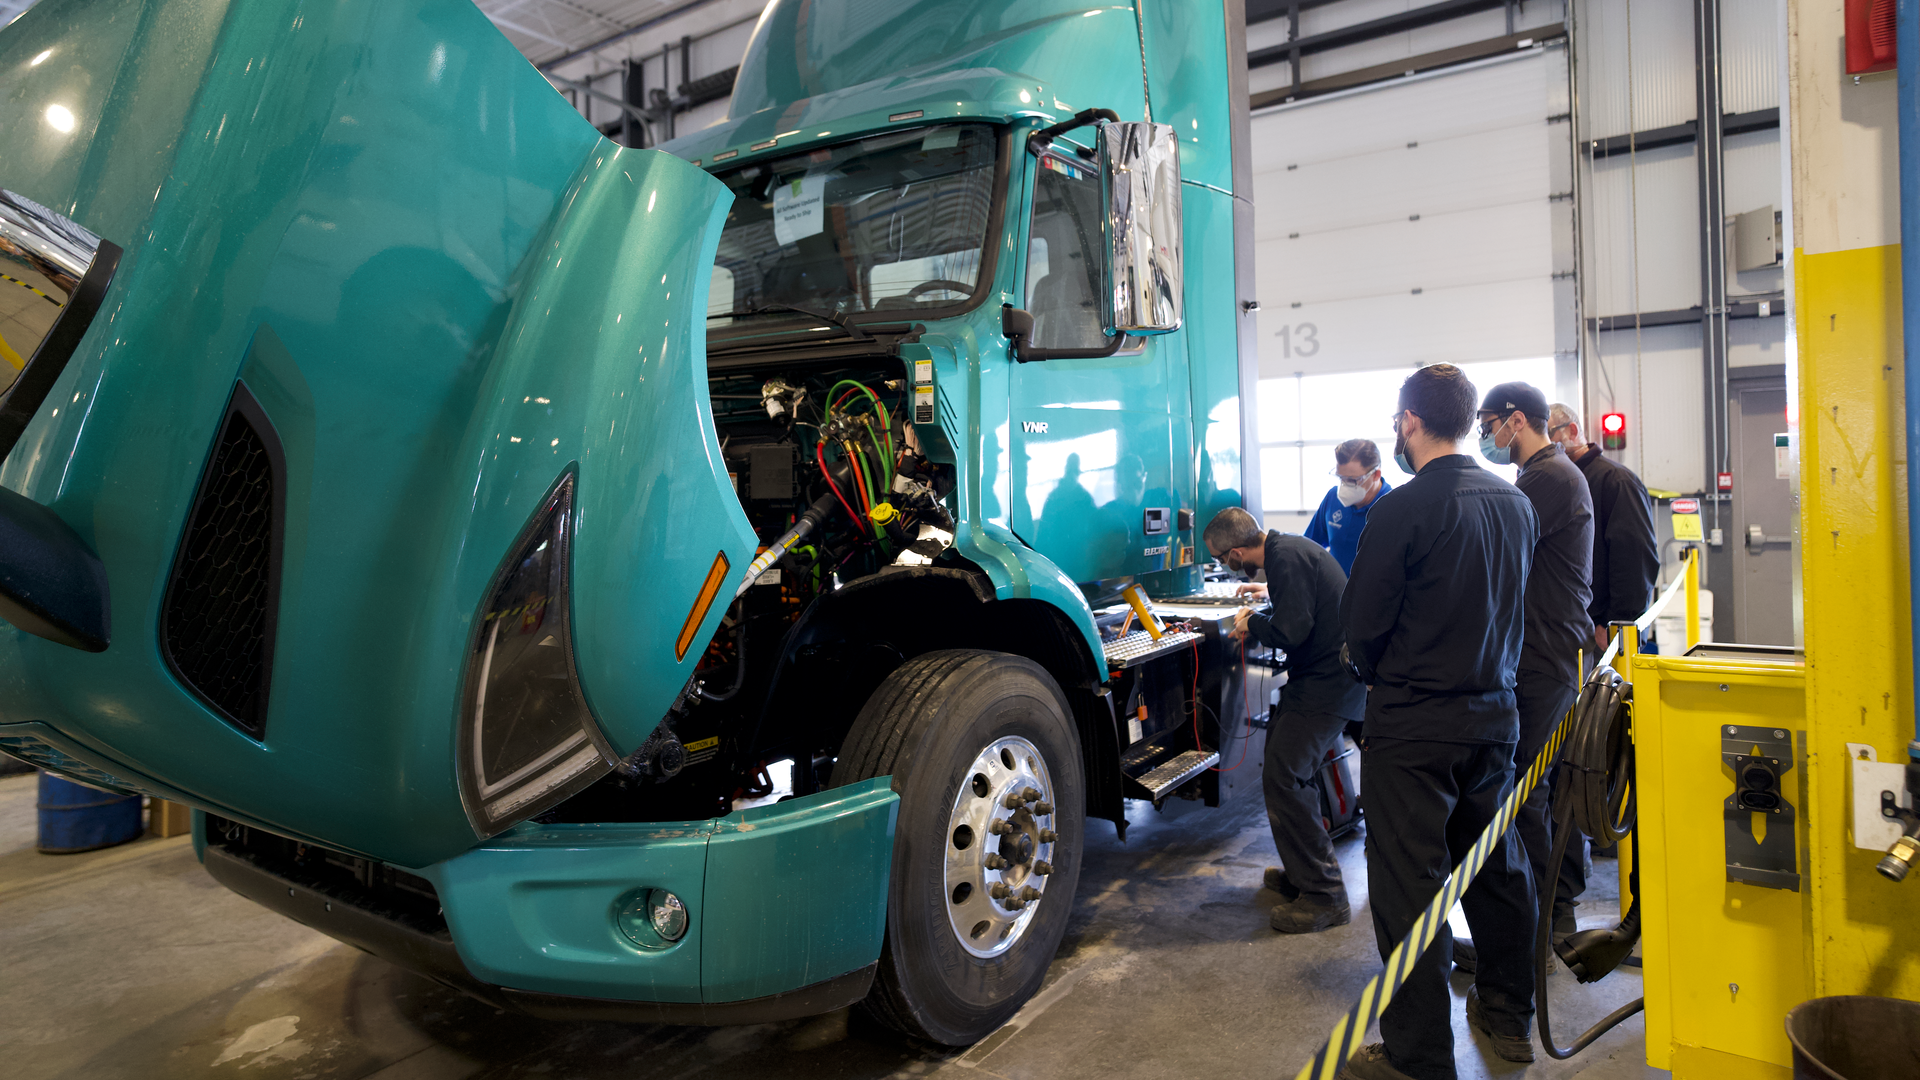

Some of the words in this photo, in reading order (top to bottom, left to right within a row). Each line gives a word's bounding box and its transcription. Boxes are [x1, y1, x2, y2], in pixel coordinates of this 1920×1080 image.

[783, 203, 800, 211] Software
[801, 196, 819, 206] Updated
[1274, 322, 1320, 358] 13
[1022, 421, 1048, 433] VNR
[1144, 546, 1169, 556] ELECTRIC
